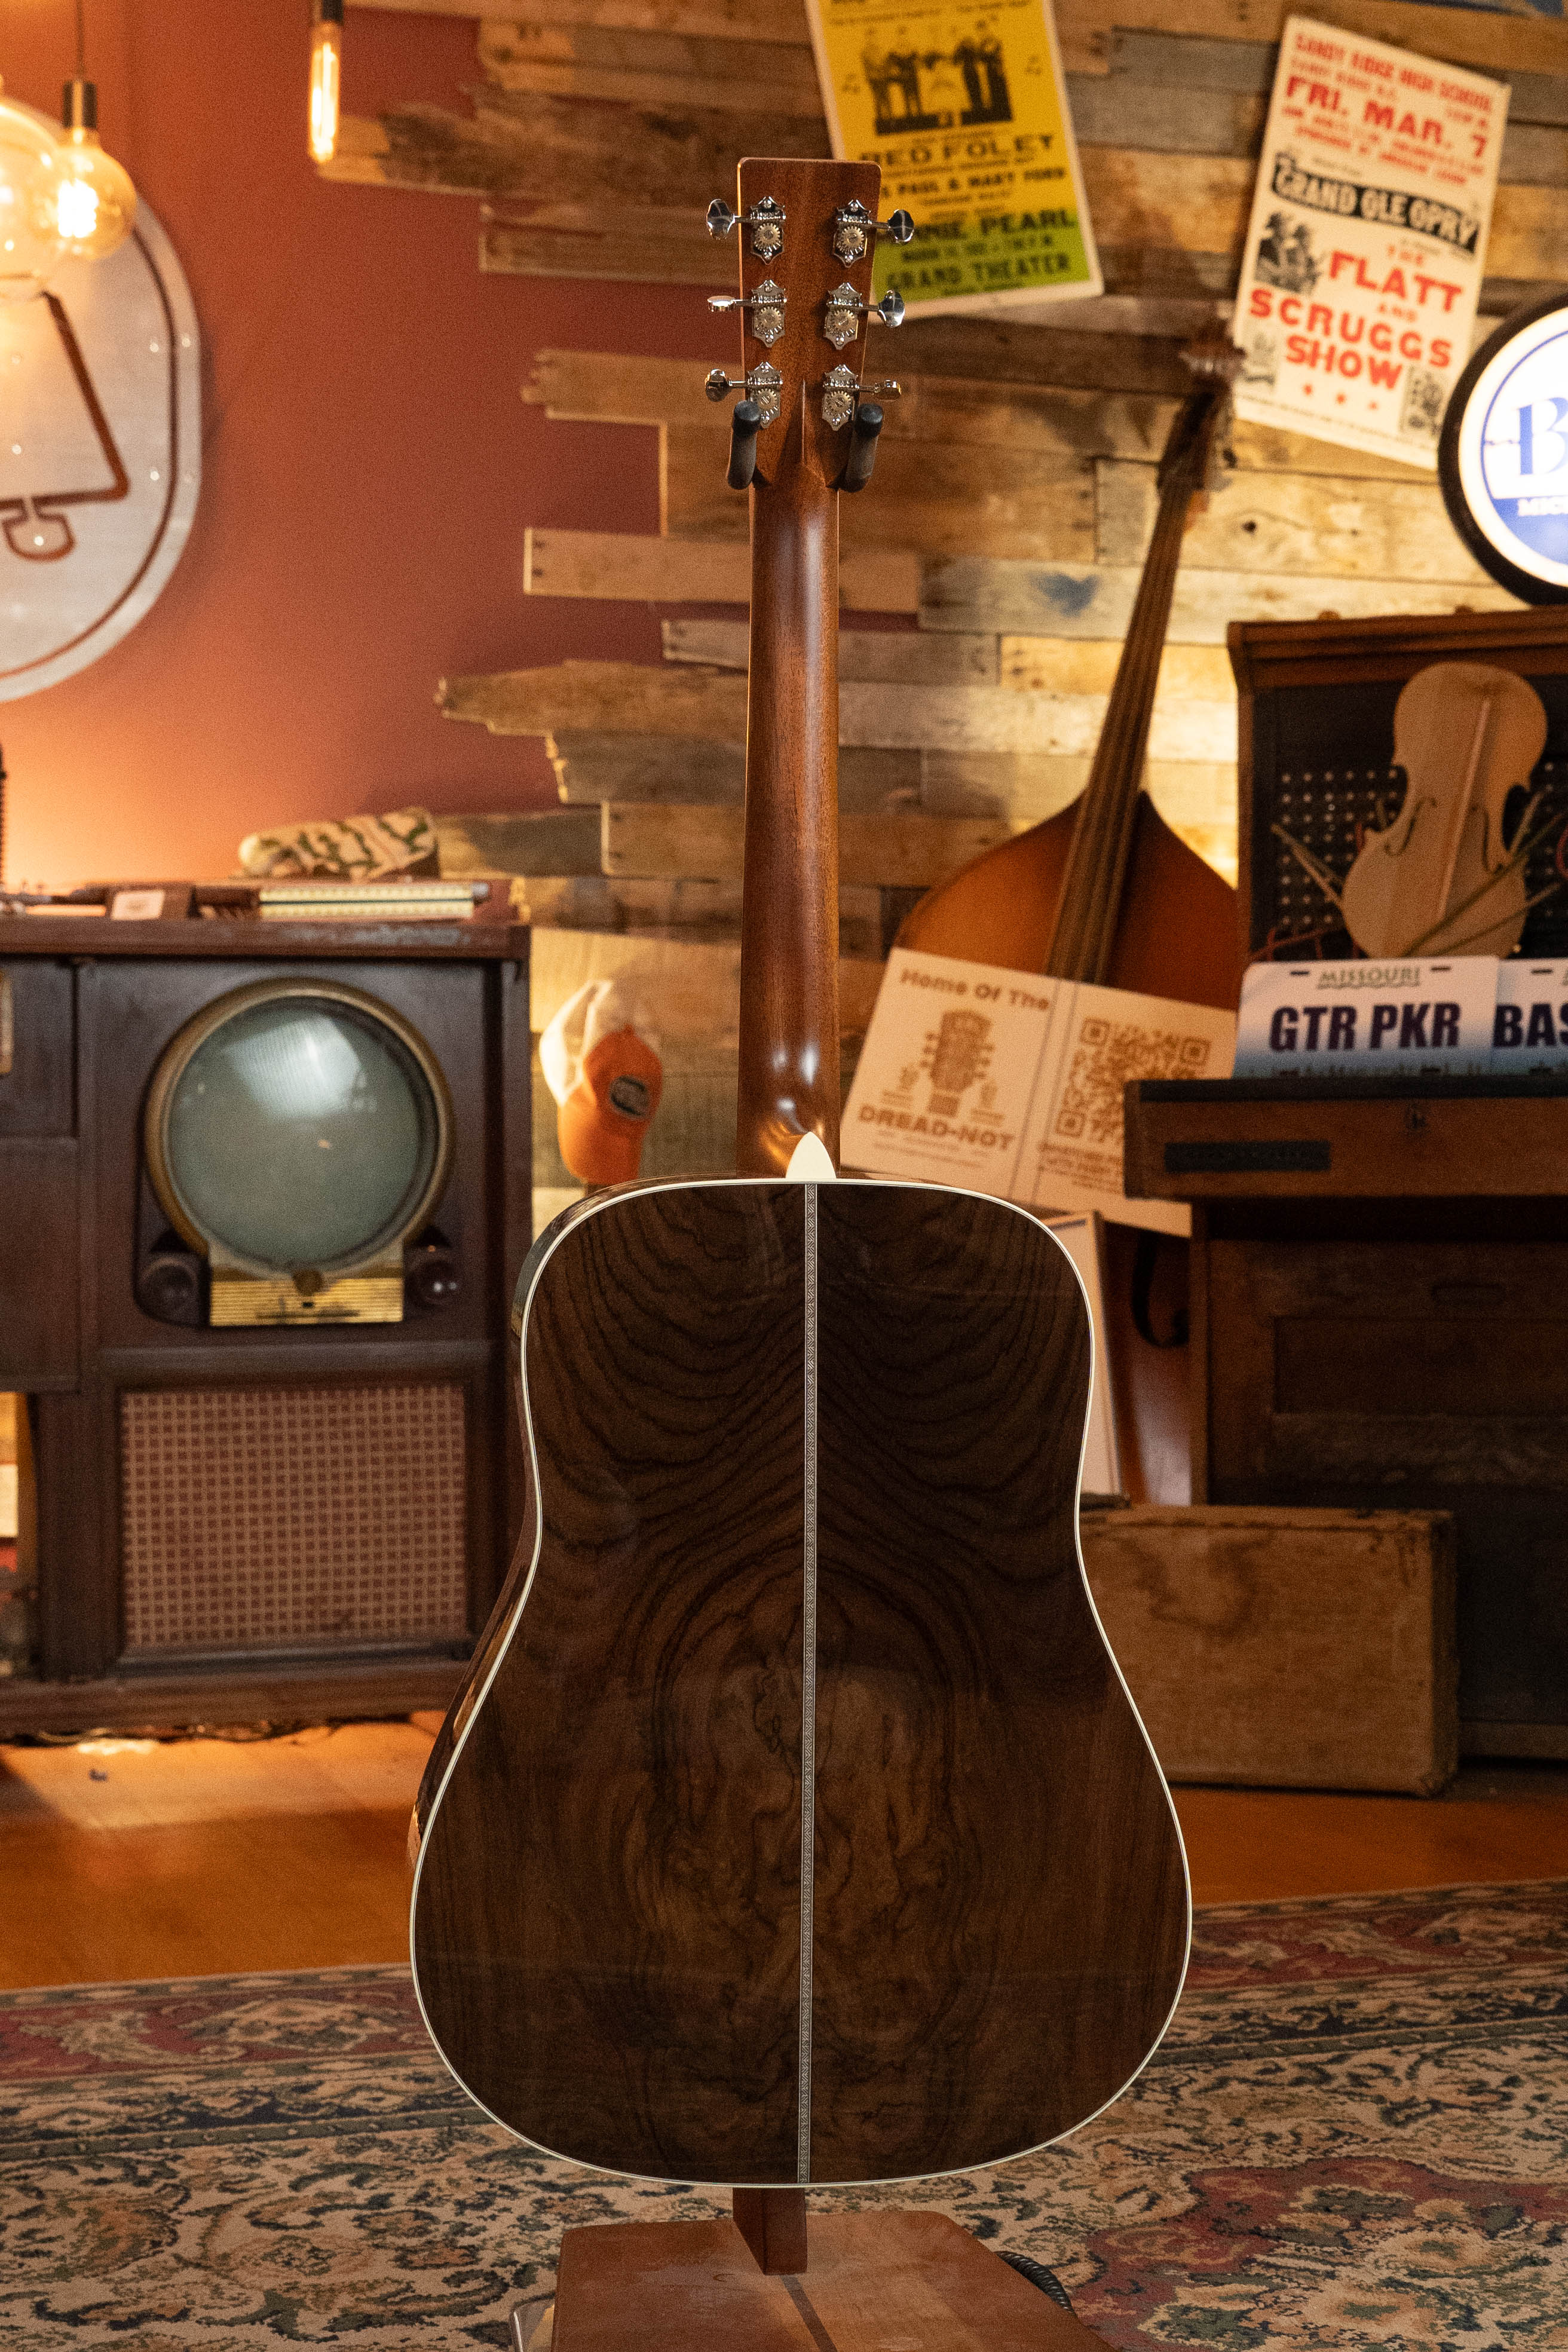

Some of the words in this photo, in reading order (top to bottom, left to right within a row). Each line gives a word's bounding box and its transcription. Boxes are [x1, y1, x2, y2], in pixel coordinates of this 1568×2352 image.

[1287, 75, 1349, 116] FRI.
[1472, 134, 1487, 158] 7
[944, 133, 1053, 160] FOLEY
[1275, 155, 1357, 216] GRAND
[1360, 188, 1408, 224] OLE
[1408, 196, 1480, 247] OPRY
[1329, 250, 1462, 313] FLATT
[1250, 287, 1454, 368] SCRUGGS
[1286, 334, 1402, 390] SHOW
[899, 969, 967, 996] Home
[974, 983, 1001, 1003] Of
[1009, 988, 1050, 1010] The
[1318, 966, 1422, 985] MISSOURI
[1269, 1006, 1357, 1052] GTR
[1370, 1002, 1460, 1049] PKR
[858, 1105, 1015, 1152] DREAD-NOT
